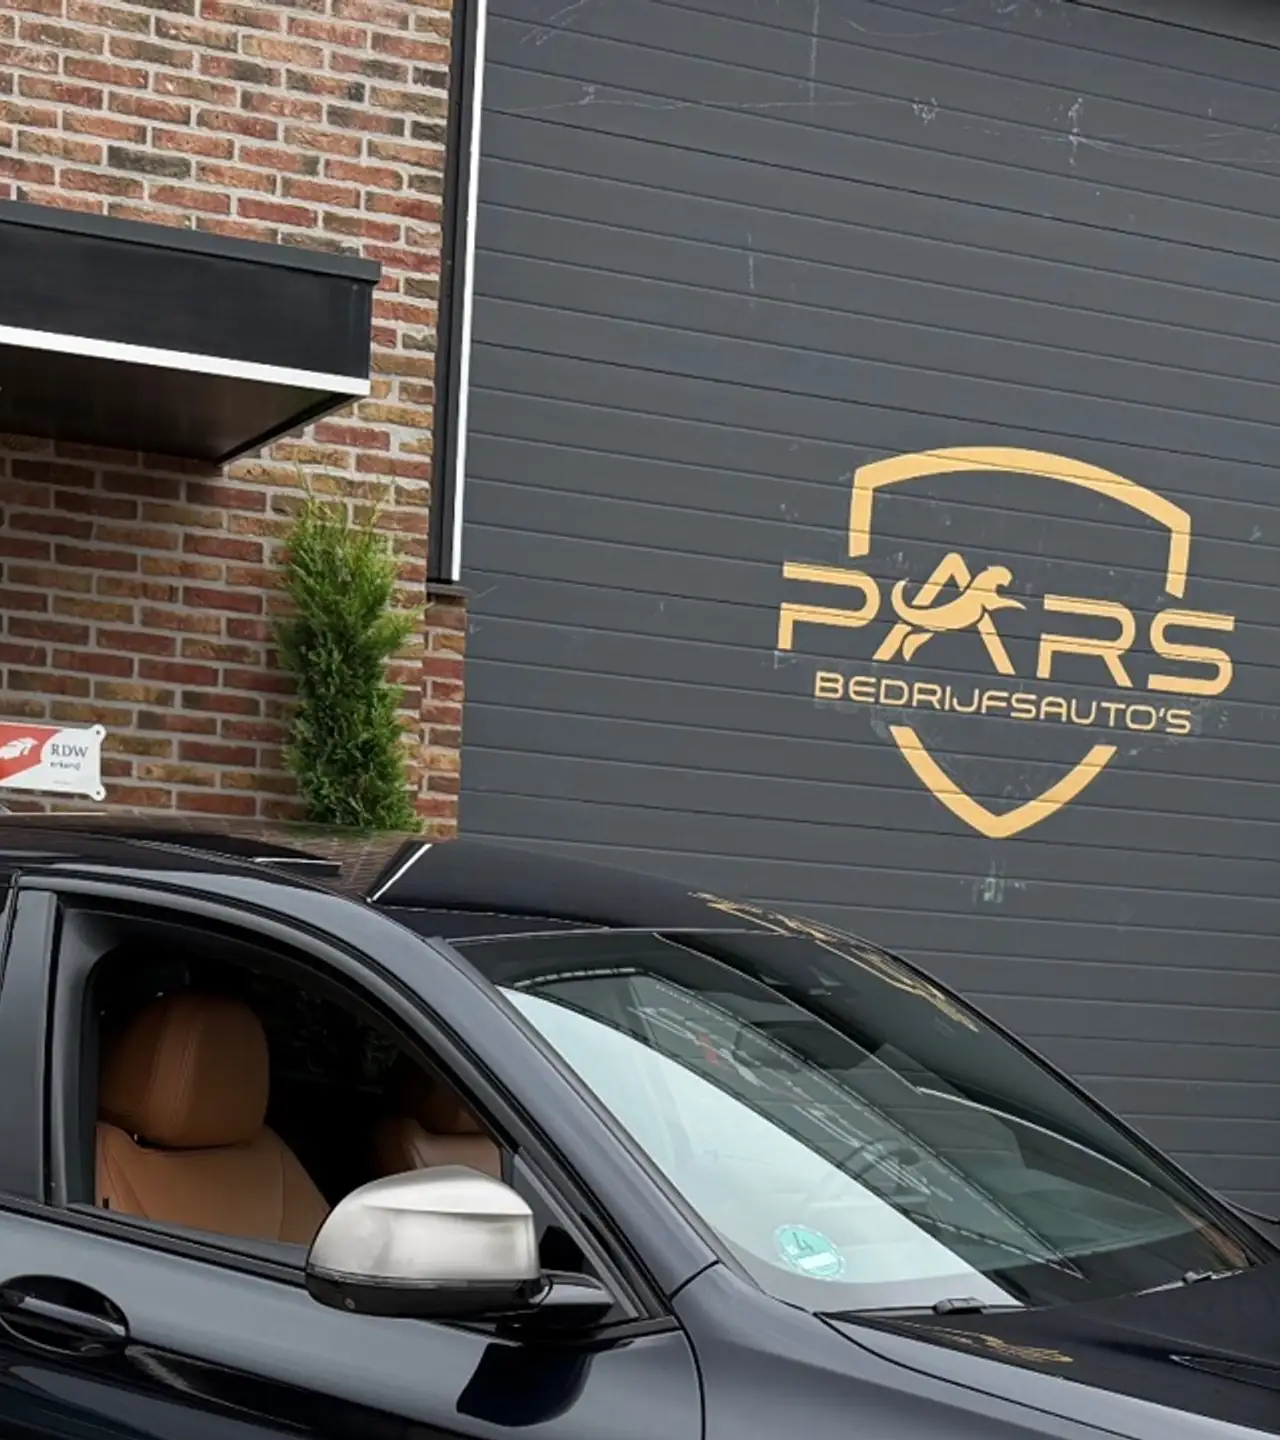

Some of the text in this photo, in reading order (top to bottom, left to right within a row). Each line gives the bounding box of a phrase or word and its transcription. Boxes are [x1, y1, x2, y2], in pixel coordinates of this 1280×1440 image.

[777, 552, 1236, 697] PARS
[814, 671, 1192, 735] BEDRIJFSAUTO'S
[51, 743, 89, 758] RDW
